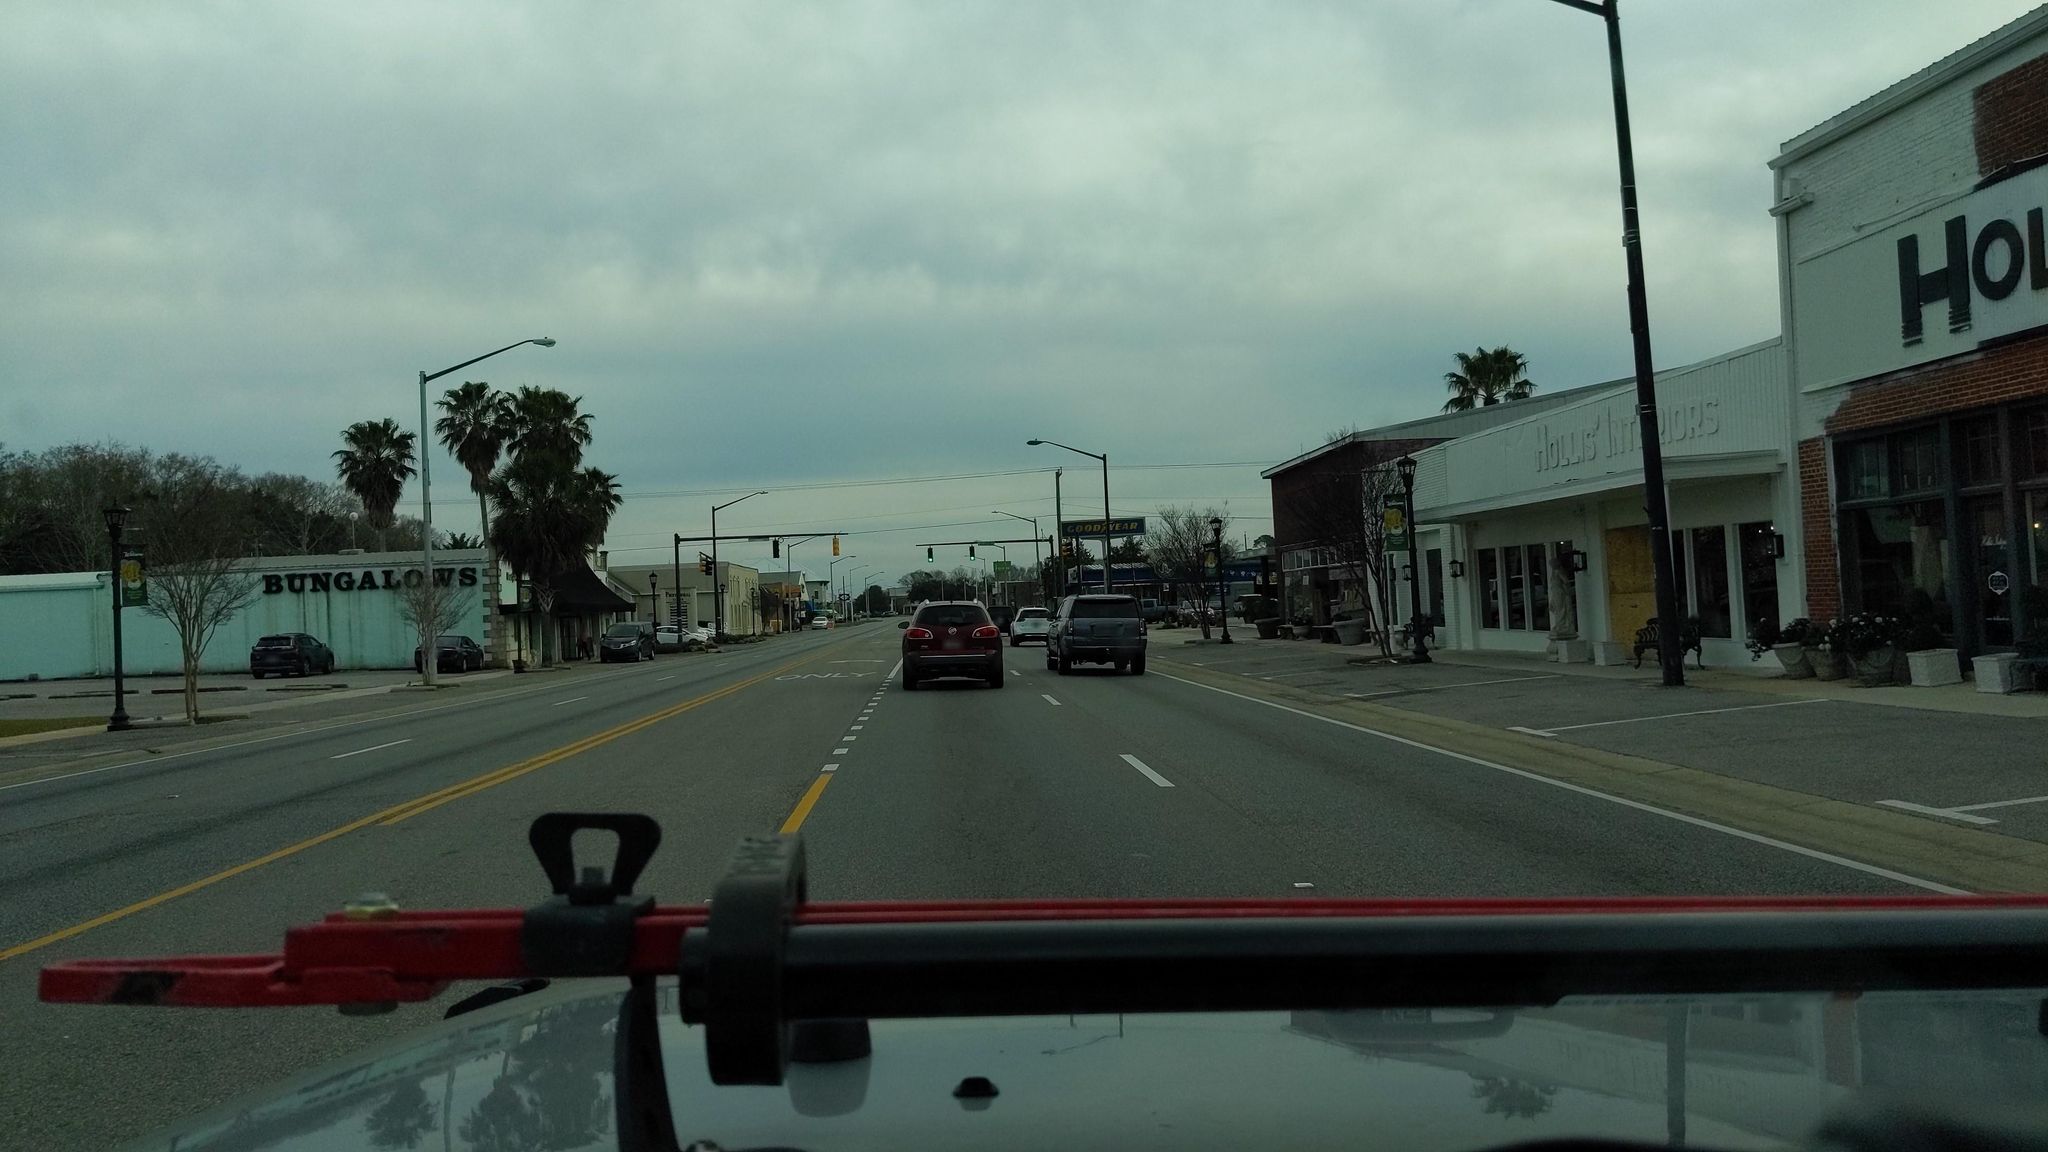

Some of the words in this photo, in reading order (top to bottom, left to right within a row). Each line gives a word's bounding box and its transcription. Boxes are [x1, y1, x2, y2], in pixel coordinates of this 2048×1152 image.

[1606, 397, 1720, 459] INTRIORS
[1067, 521, 1138, 534] GOODYEAR
[262, 567, 478, 594] BUNGALOWS
[774, 672, 877, 681] ONLY
